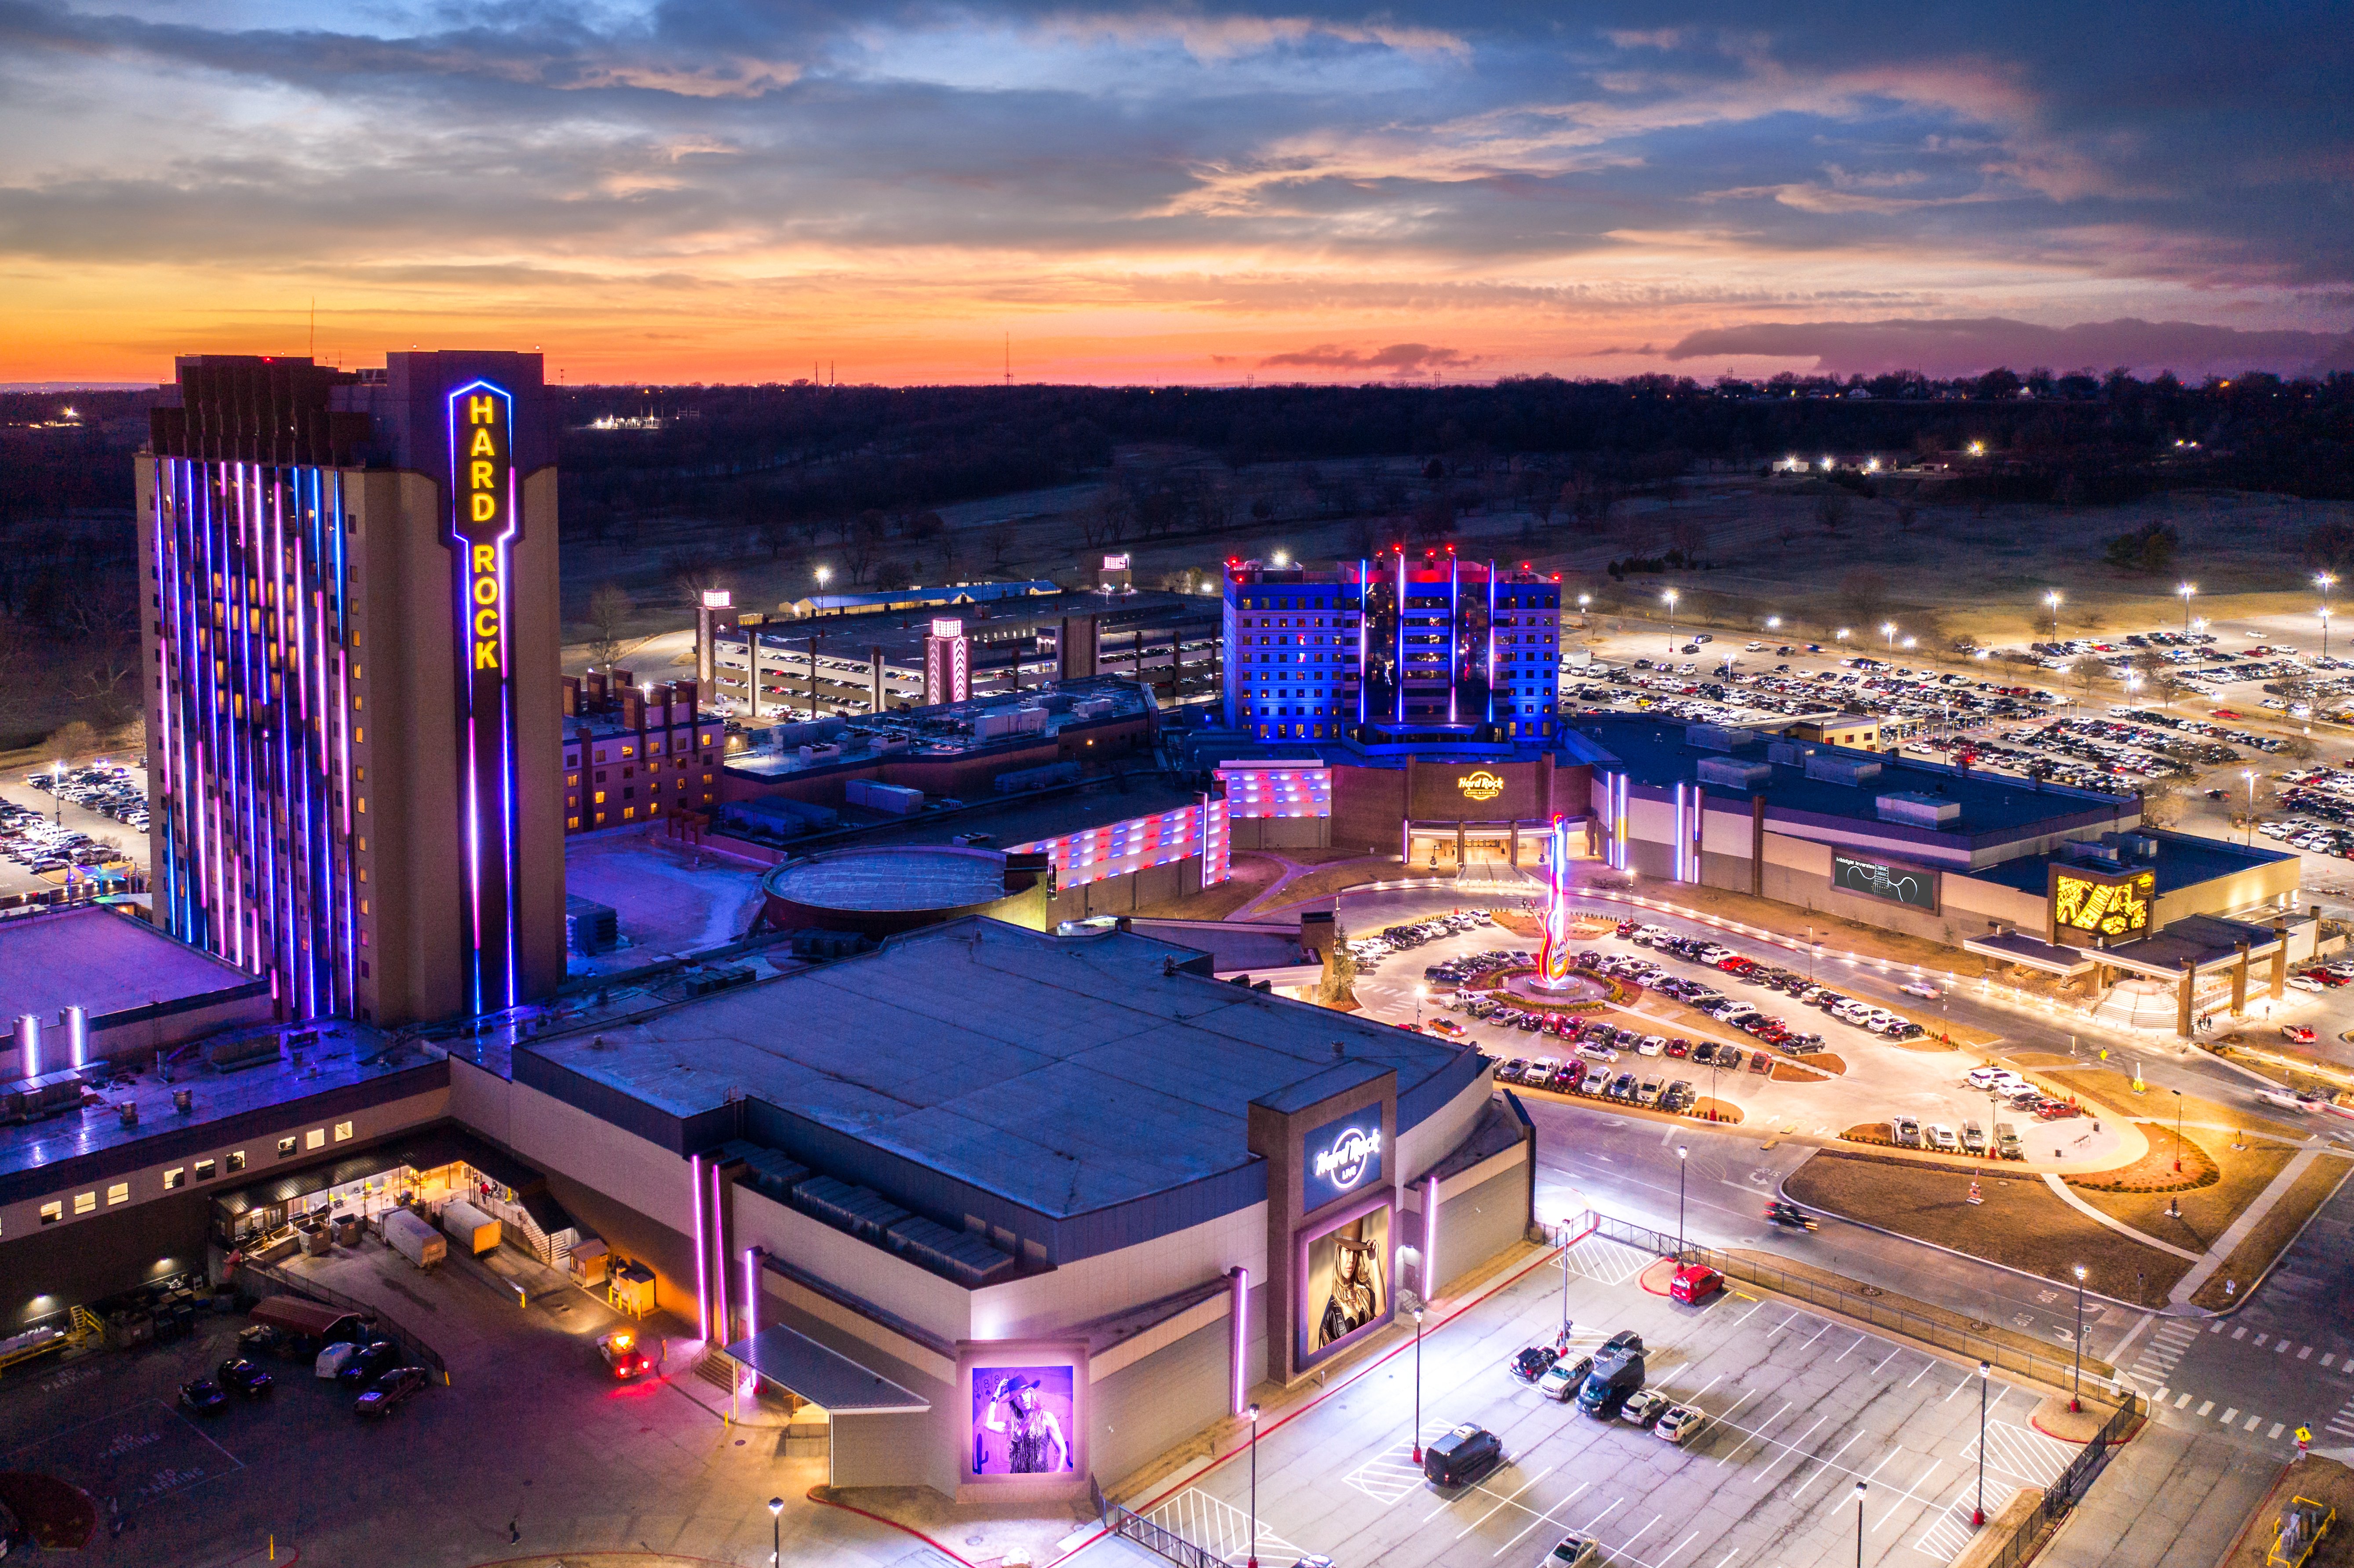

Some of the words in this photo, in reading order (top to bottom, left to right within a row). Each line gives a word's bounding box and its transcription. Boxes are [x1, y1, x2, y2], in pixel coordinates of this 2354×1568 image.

[470, 396, 495, 522] HARD
[473, 544, 499, 669] ROCK
[1458, 777, 1482, 788] Hard
[1481, 777, 1504, 789] Rock
[1836, 857, 1854, 865] Midnight
[2088, 888, 2112, 917] TULSA
[1342, 1165, 1357, 1180] LIVE
[1756, 1168, 1781, 1177] STOP
